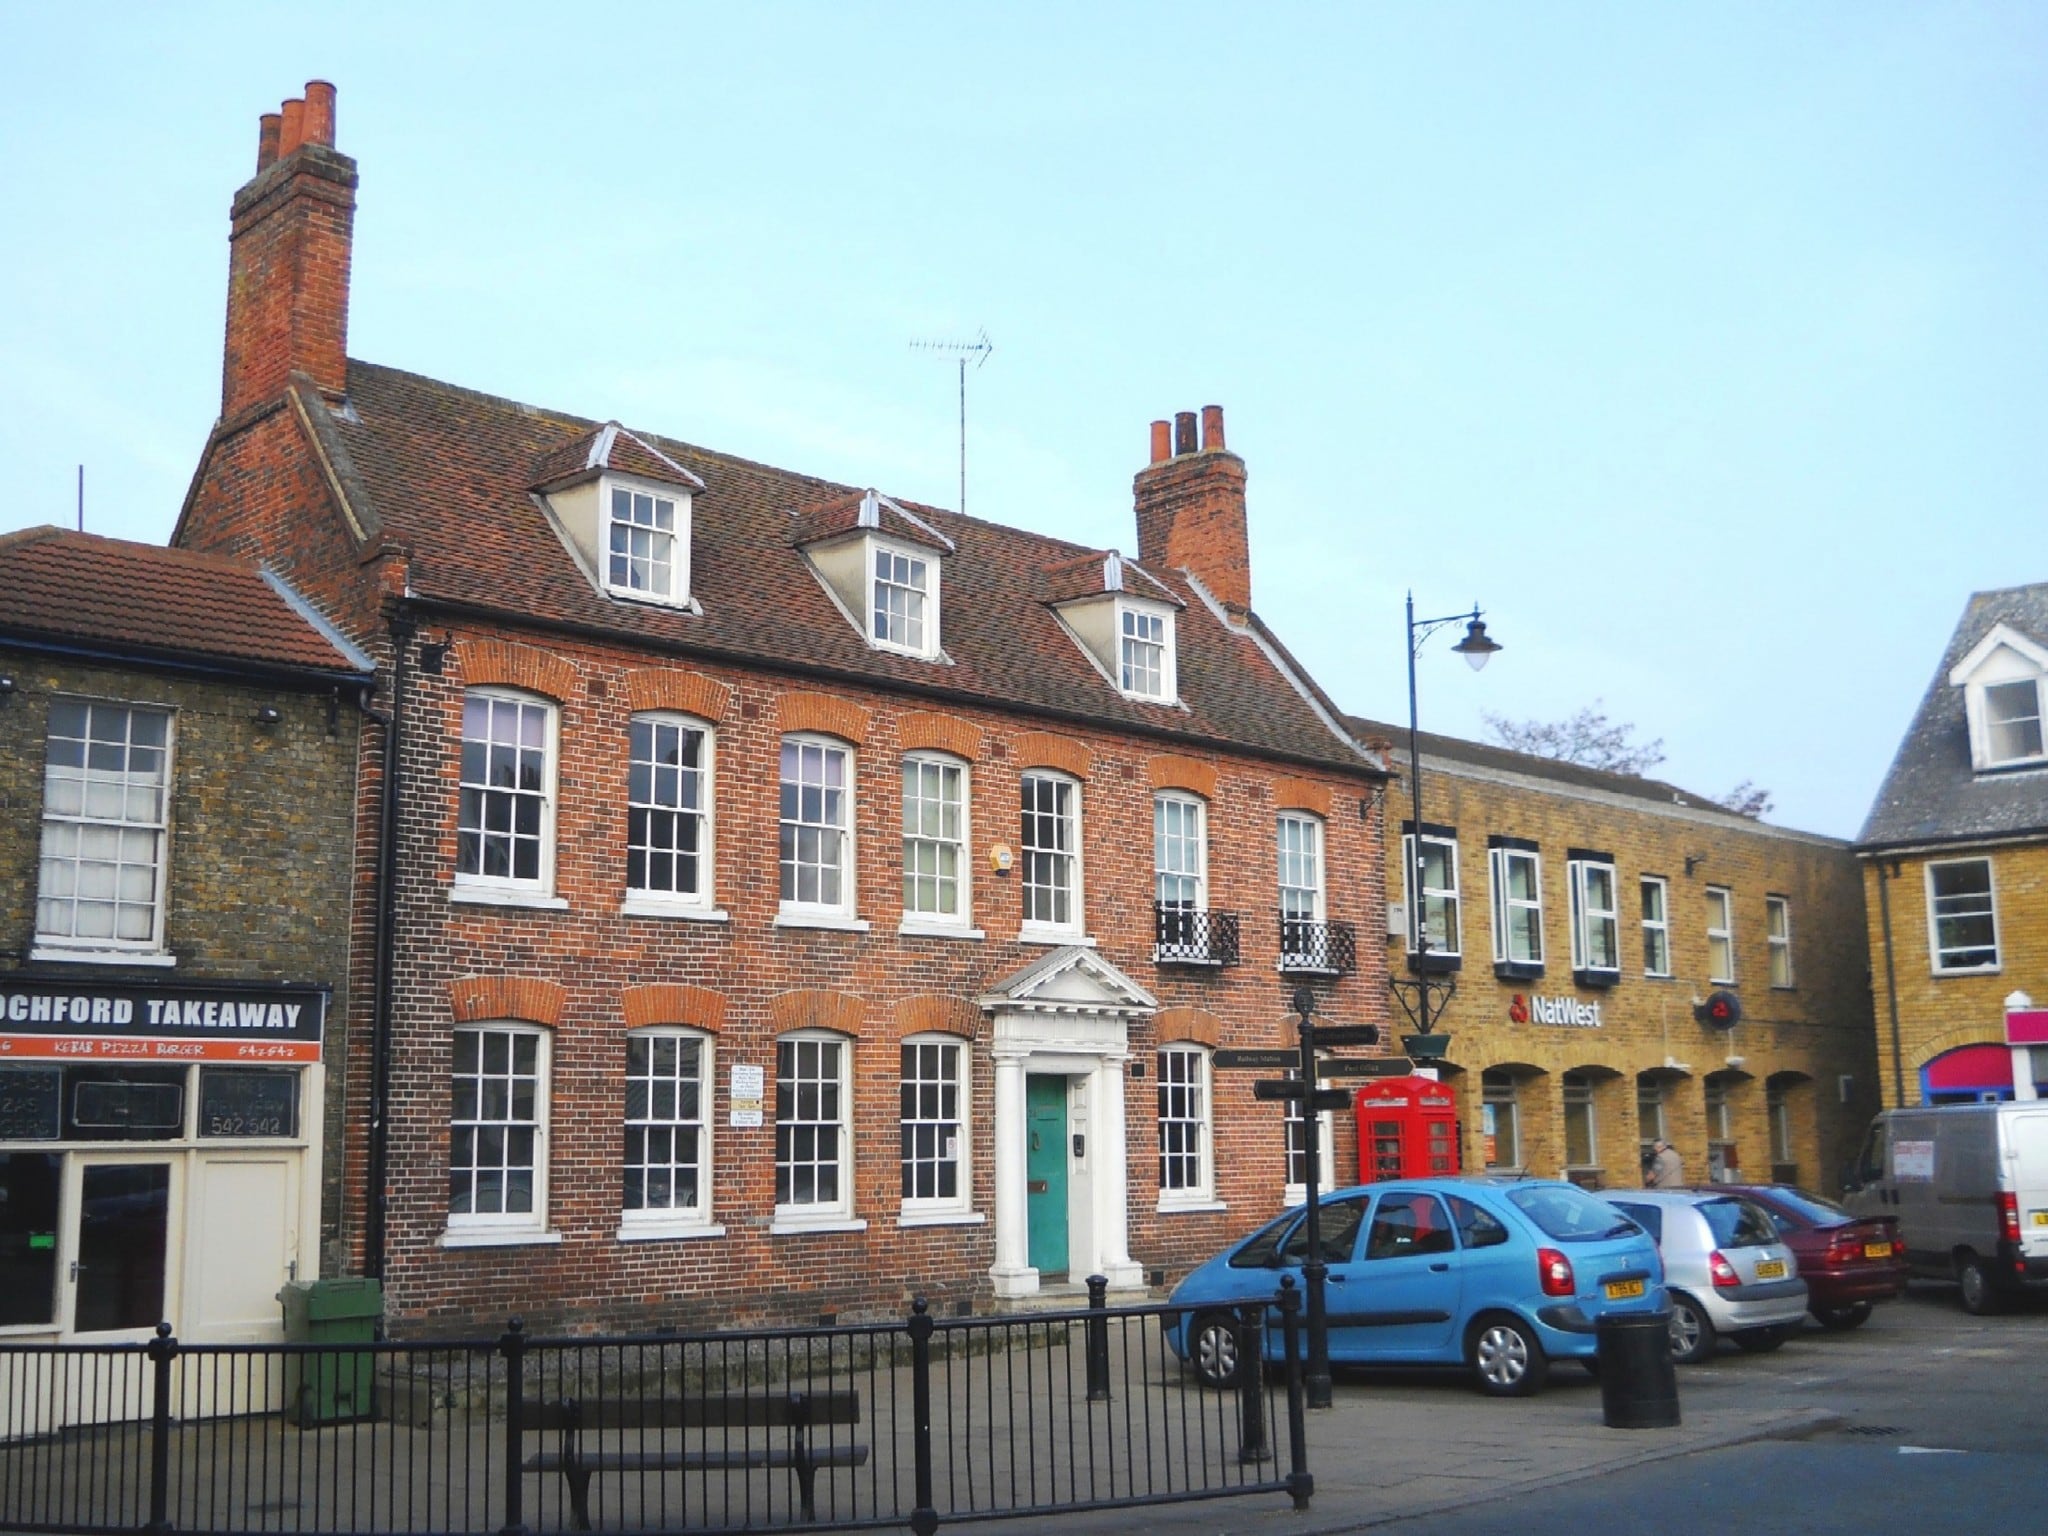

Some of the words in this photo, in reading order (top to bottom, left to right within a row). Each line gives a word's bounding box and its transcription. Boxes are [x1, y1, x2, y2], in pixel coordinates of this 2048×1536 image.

[0, 994, 133, 1024] CHFORD
[148, 1000, 302, 1028] TAKEAWAY
[1530, 995, 1601, 1027] NatWest
[54, 1041, 93, 1053] KEBAB
[102, 1042, 148, 1054] PIZZA
[156, 1043, 205, 1055] BURGER
[211, 1116, 243, 1135] 542
